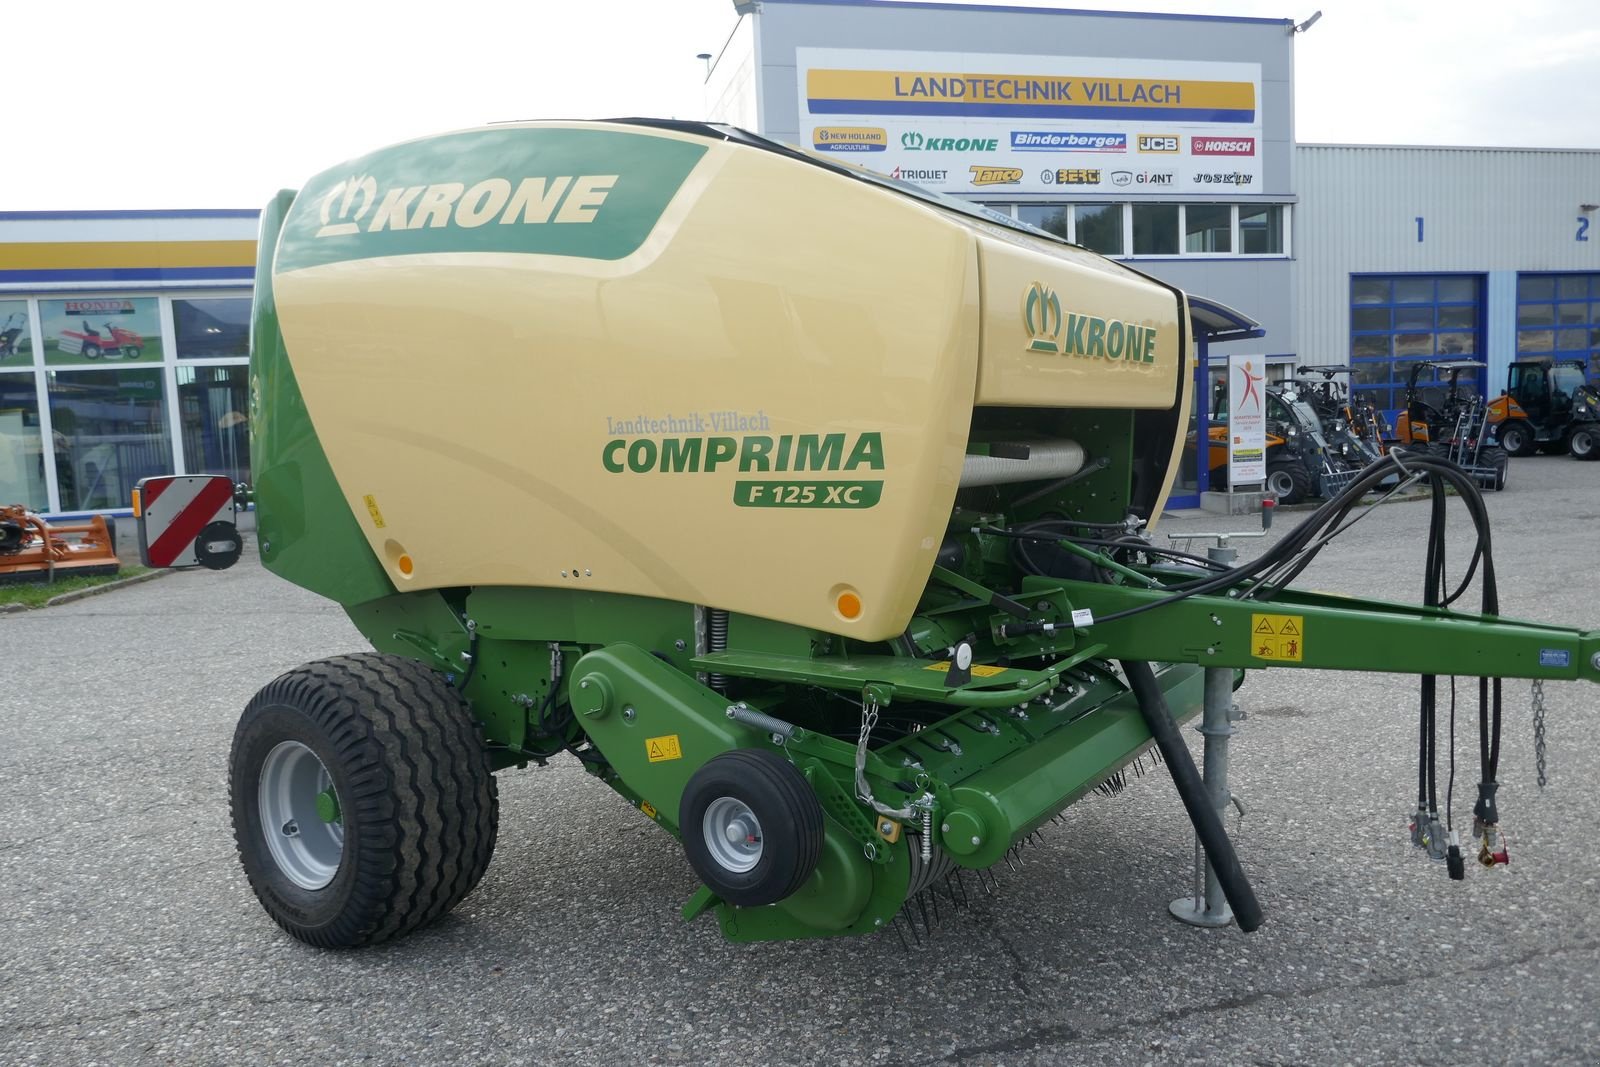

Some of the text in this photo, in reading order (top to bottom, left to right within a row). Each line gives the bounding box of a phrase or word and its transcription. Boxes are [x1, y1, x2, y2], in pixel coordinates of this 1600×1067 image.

[894, 76, 1181, 104] LANDTECHNIK VILLACH
[848, 133, 881, 141] HOLLAND
[925, 138, 999, 152] KRONE
[1015, 133, 1123, 147] Binderberger
[1140, 137, 1177, 151] JCB
[1204, 141, 1252, 152] HORSCH
[900, 169, 948, 180] TRIOLIET
[969, 166, 1023, 184] Tanco
[1193, 172, 1253, 185] JOSKIN
[367, 174, 620, 233] KRONE
[1415, 217, 1424, 242] 1
[1575, 217, 1589, 242] 2
[64, 301, 135, 311] HONDA
[1063, 312, 1156, 364] KRONE
[607, 410, 770, 435] Landtechnik-Villach
[602, 431, 885, 474] COMPRIMA
[749, 485, 863, 504] F 125 XC
